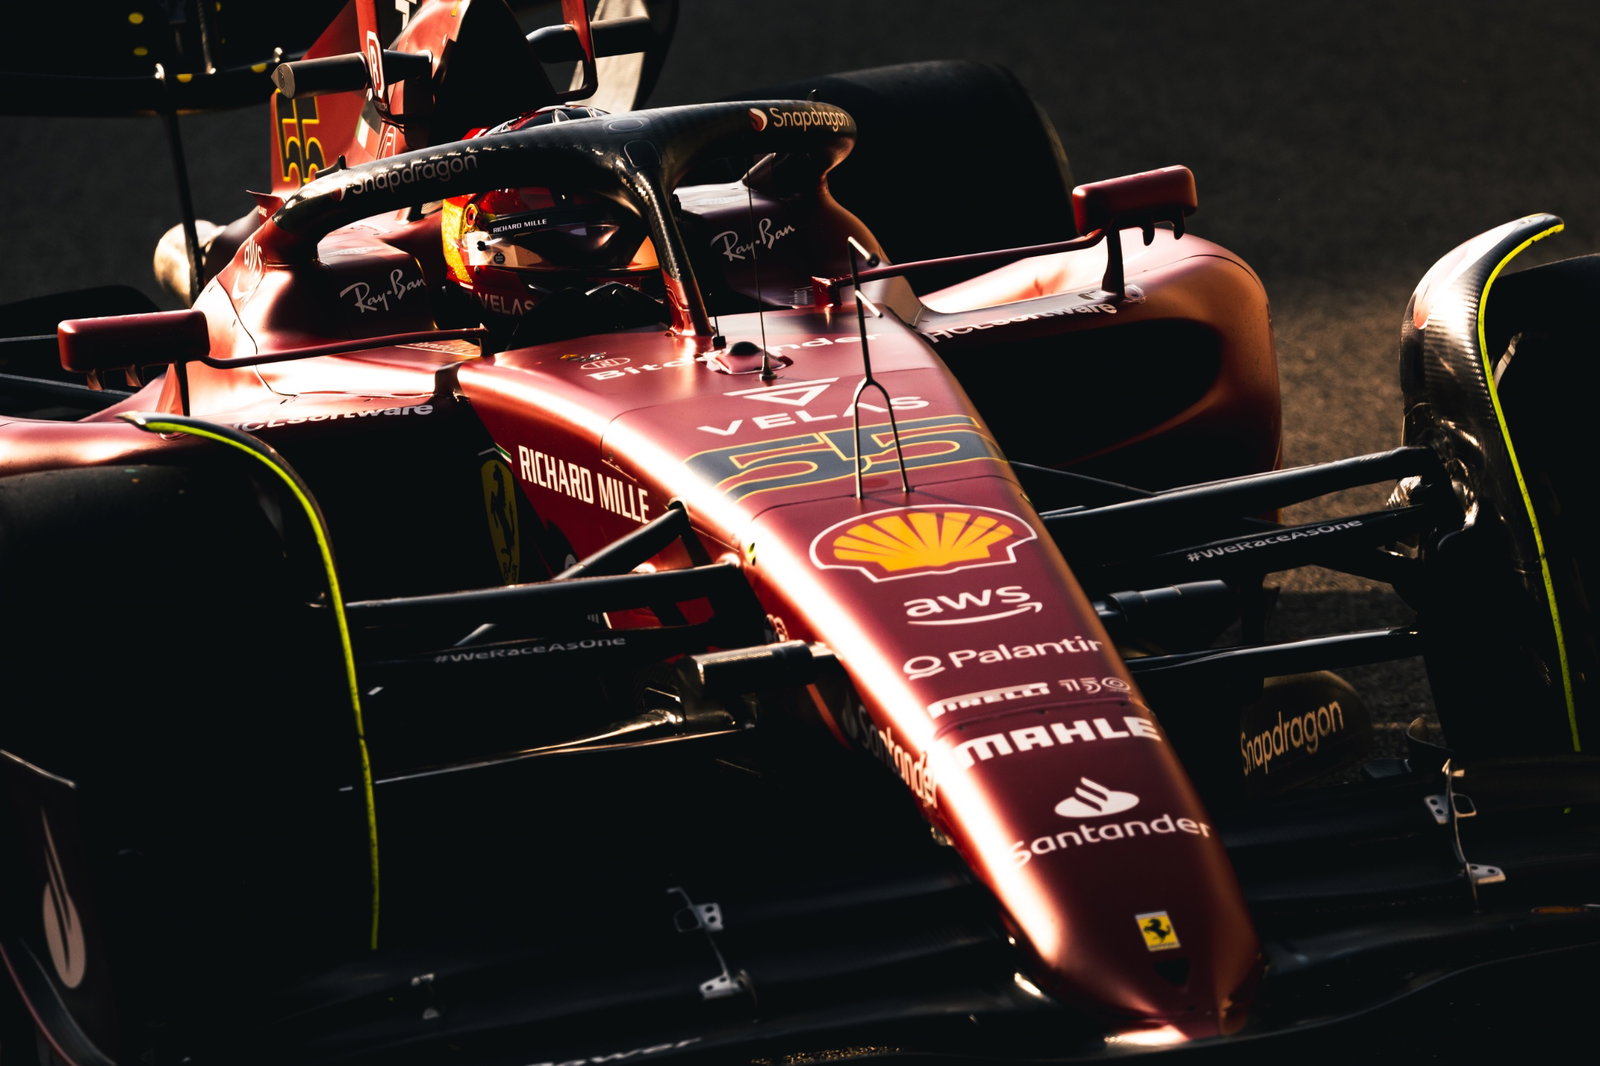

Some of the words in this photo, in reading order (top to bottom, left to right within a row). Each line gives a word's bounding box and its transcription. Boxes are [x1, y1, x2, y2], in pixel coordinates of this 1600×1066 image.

[769, 106, 850, 133] Snapdragon
[492, 221, 522, 234] RICHARD
[523, 218, 548, 229] MILLE
[709, 217, 796, 263] Ray-Ban
[339, 268, 427, 314] Ray-Ban
[696, 395, 930, 437] VELAS
[684, 413, 1010, 502] 55
[518, 444, 595, 505] RICHARD
[596, 472, 652, 525] MILLE
[1186, 518, 1364, 563] #WeRaceAsOne
[903, 585, 1031, 618] aws
[432, 636, 627, 664] #WeRaceAsOne
[948, 635, 1103, 669] Palantir
[951, 716, 1162, 770] MAHLE
[1240, 699, 1345, 777] Snapdragon
[1006, 813, 1210, 868] Santander
